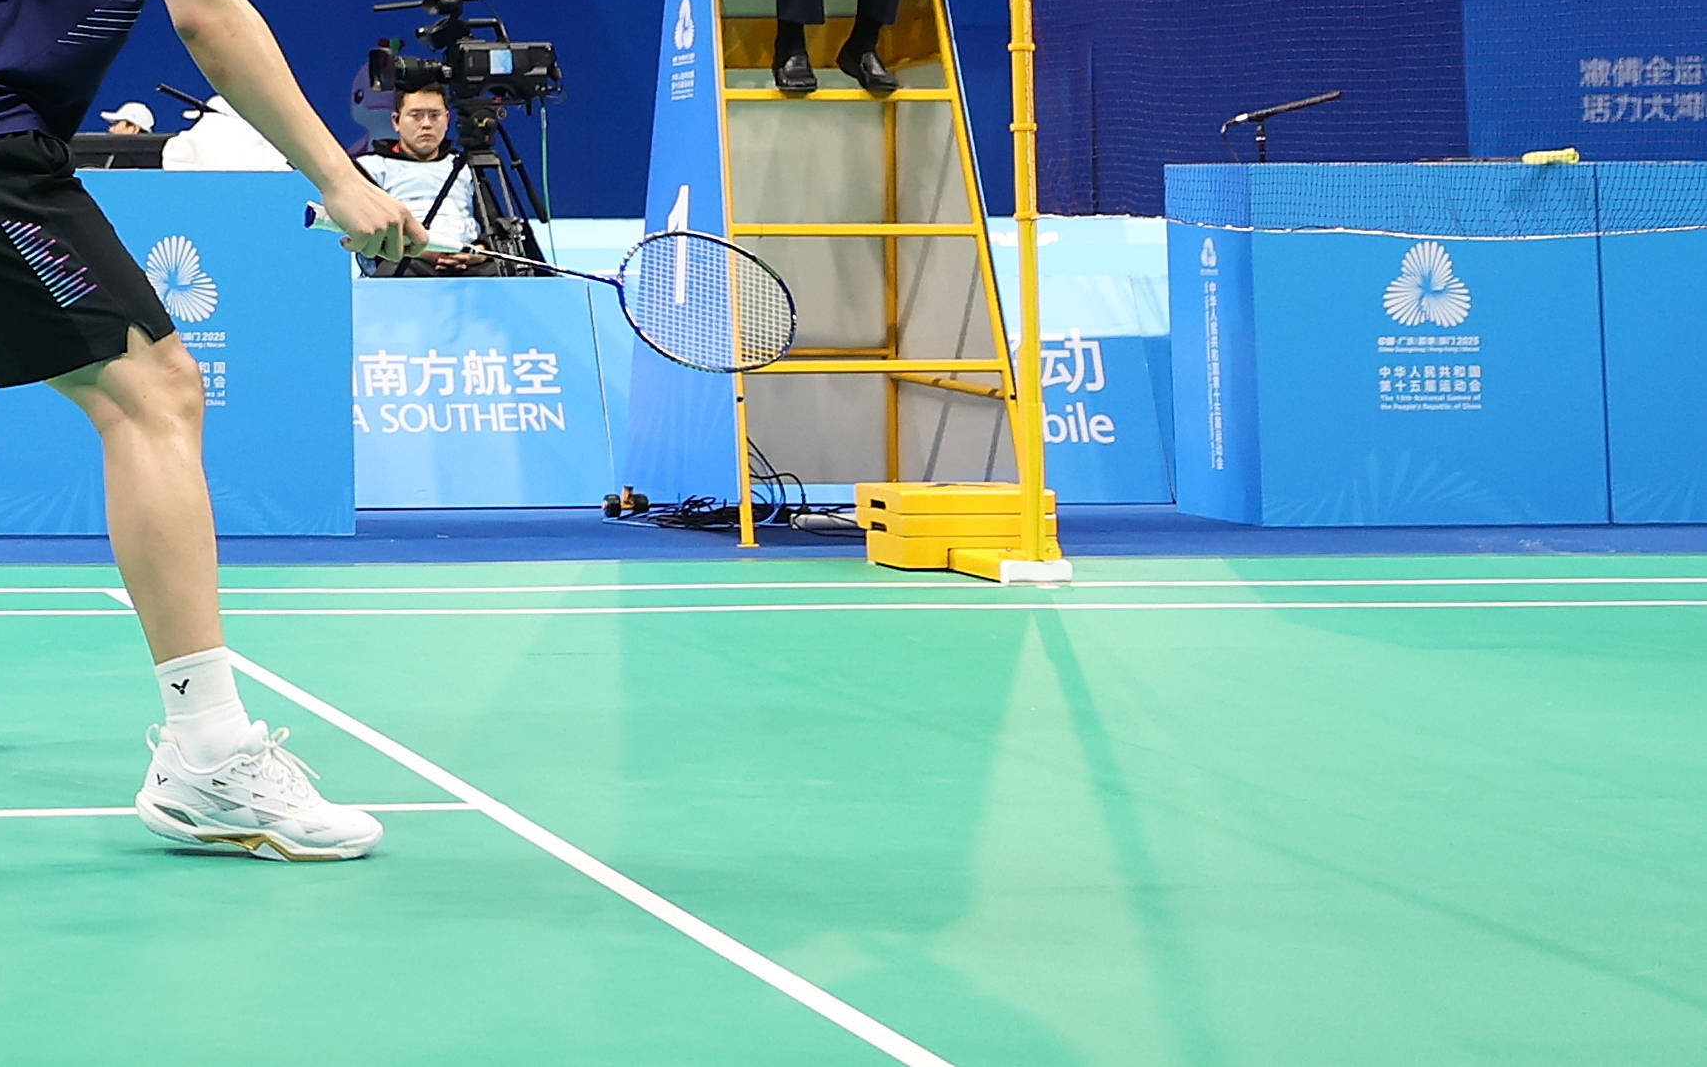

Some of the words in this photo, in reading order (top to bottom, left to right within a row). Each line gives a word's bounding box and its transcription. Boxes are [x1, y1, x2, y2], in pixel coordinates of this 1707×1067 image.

[1579, 54, 1707, 88] 激情全运
[1582, 91, 1707, 123] 活力大湾
[667, 184, 690, 304] 1
[201, 332, 226, 342] 2025
[352, 349, 563, 397] 南方航空
[1379, 365, 1482, 378] 中华人民共和国
[379, 402, 566, 433] SOUTHERN
